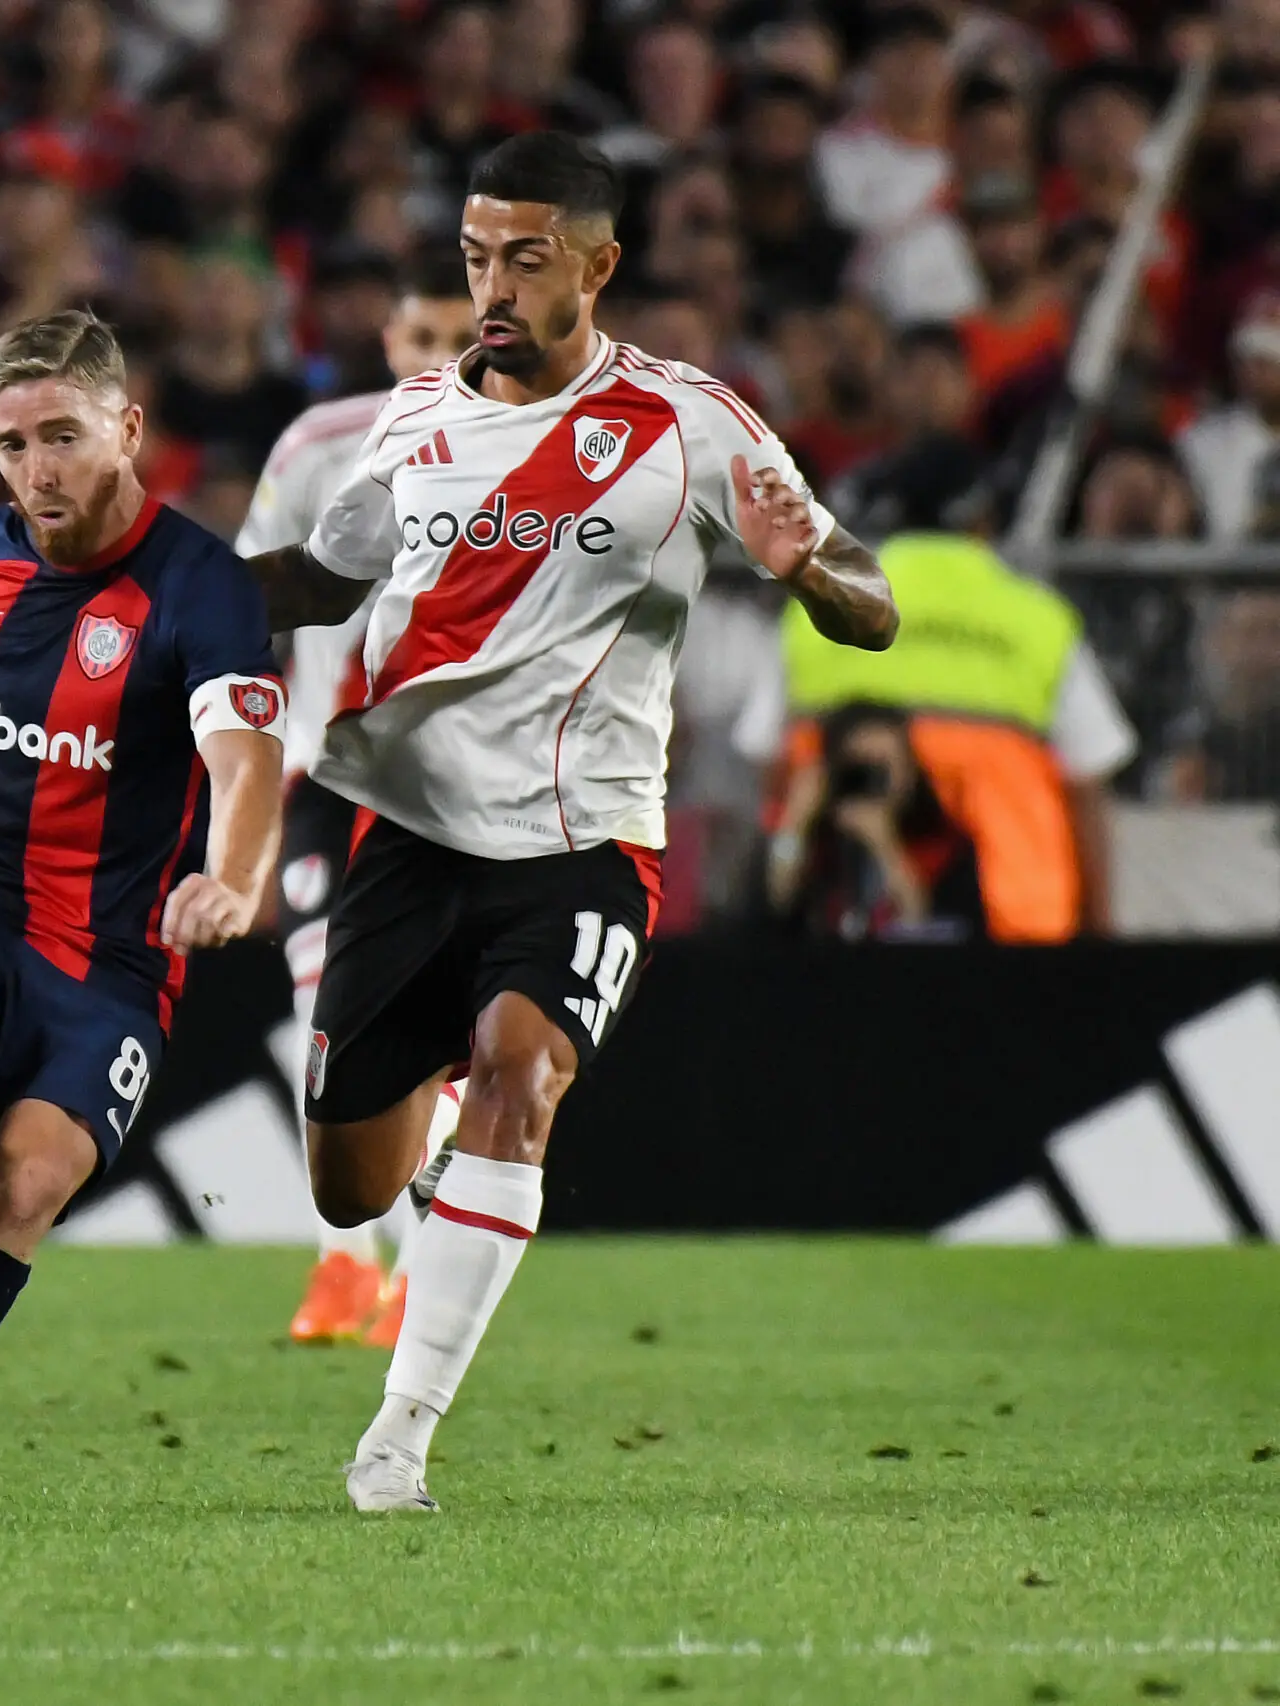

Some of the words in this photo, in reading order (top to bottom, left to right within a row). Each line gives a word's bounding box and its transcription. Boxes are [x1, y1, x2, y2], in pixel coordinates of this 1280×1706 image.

[402, 494, 616, 557] codere
[570, 911, 637, 1014] 10
[109, 1036, 148, 1101] 8
